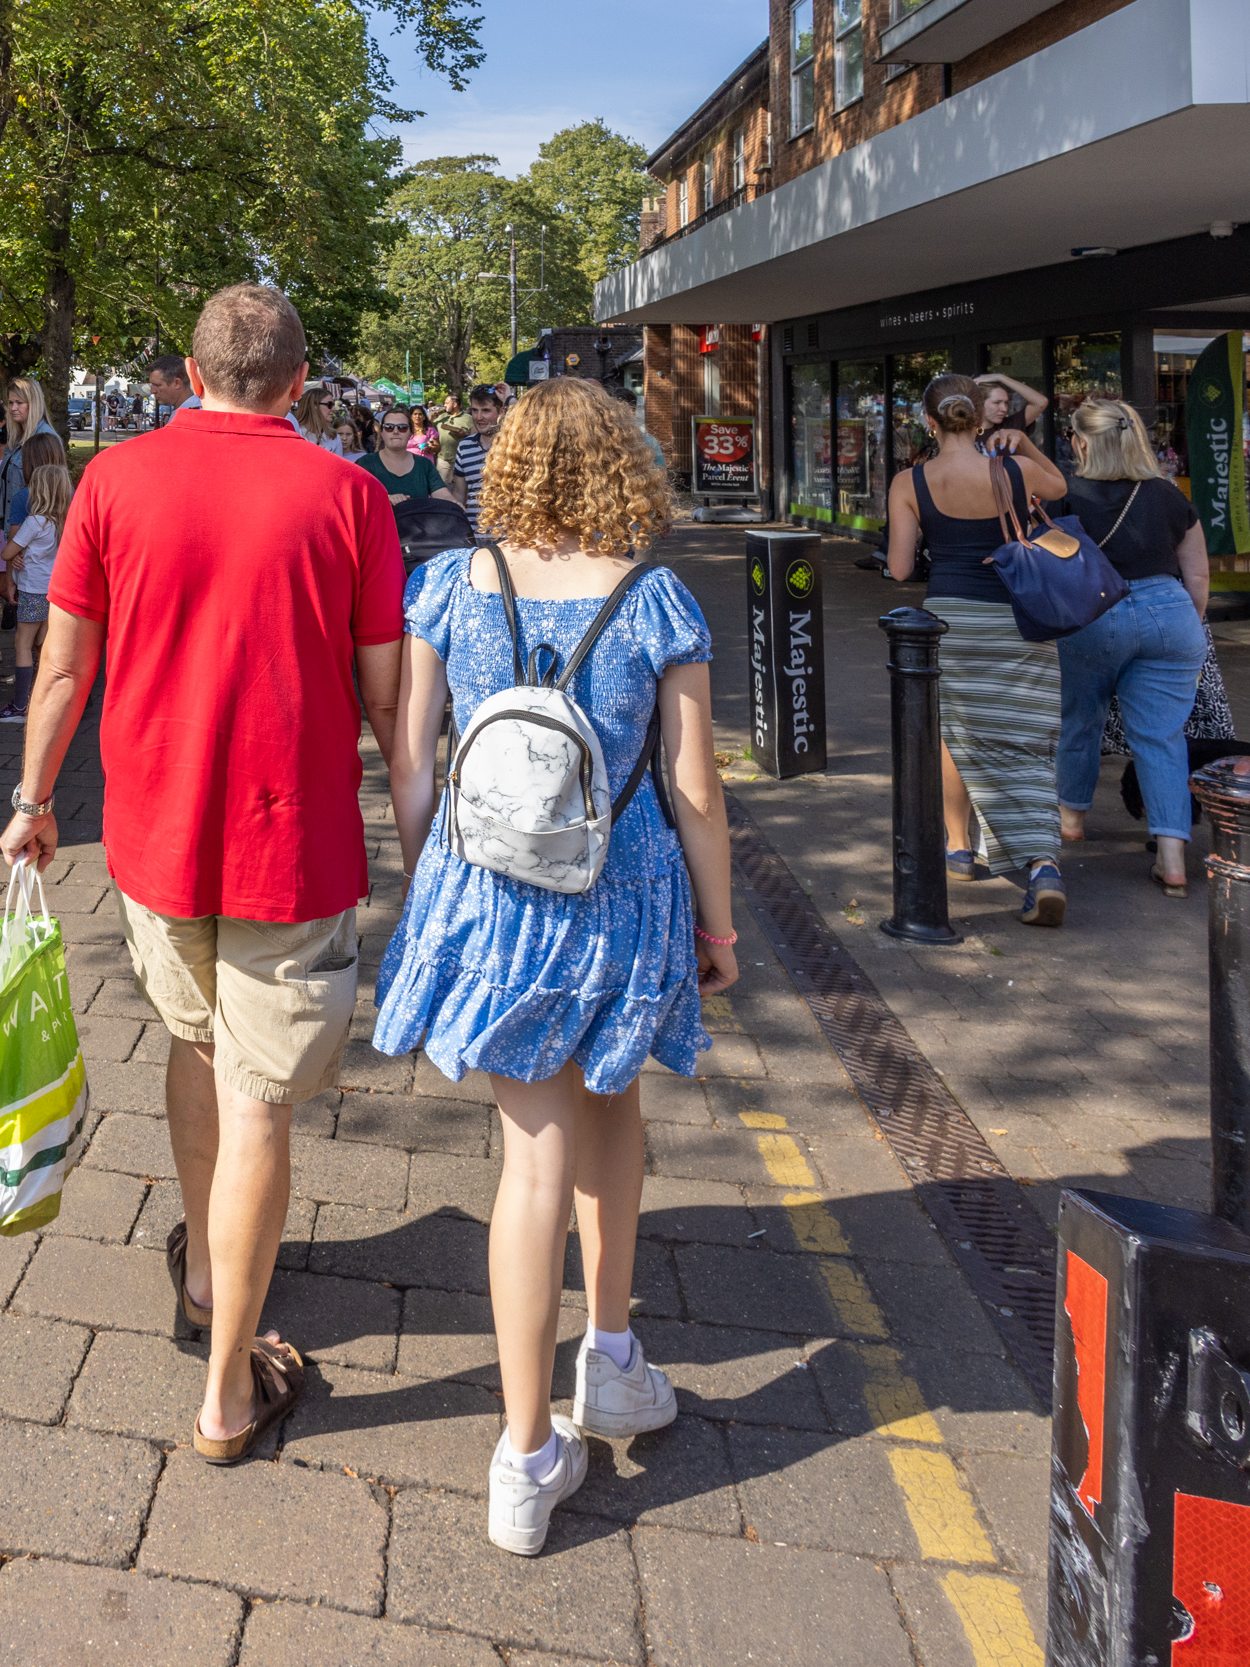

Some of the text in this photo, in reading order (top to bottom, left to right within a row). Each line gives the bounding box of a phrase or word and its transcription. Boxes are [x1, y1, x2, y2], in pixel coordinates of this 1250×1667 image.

[880, 302, 974, 328] wines beers spirits
[710, 424, 738, 434] Save
[704, 435, 749, 455] 33%
[702, 463, 749, 475] The Majestic
[702, 473, 749, 482] Parcel Event
[751, 605, 768, 748] Majestic
[783, 609, 814, 754] Majestic
